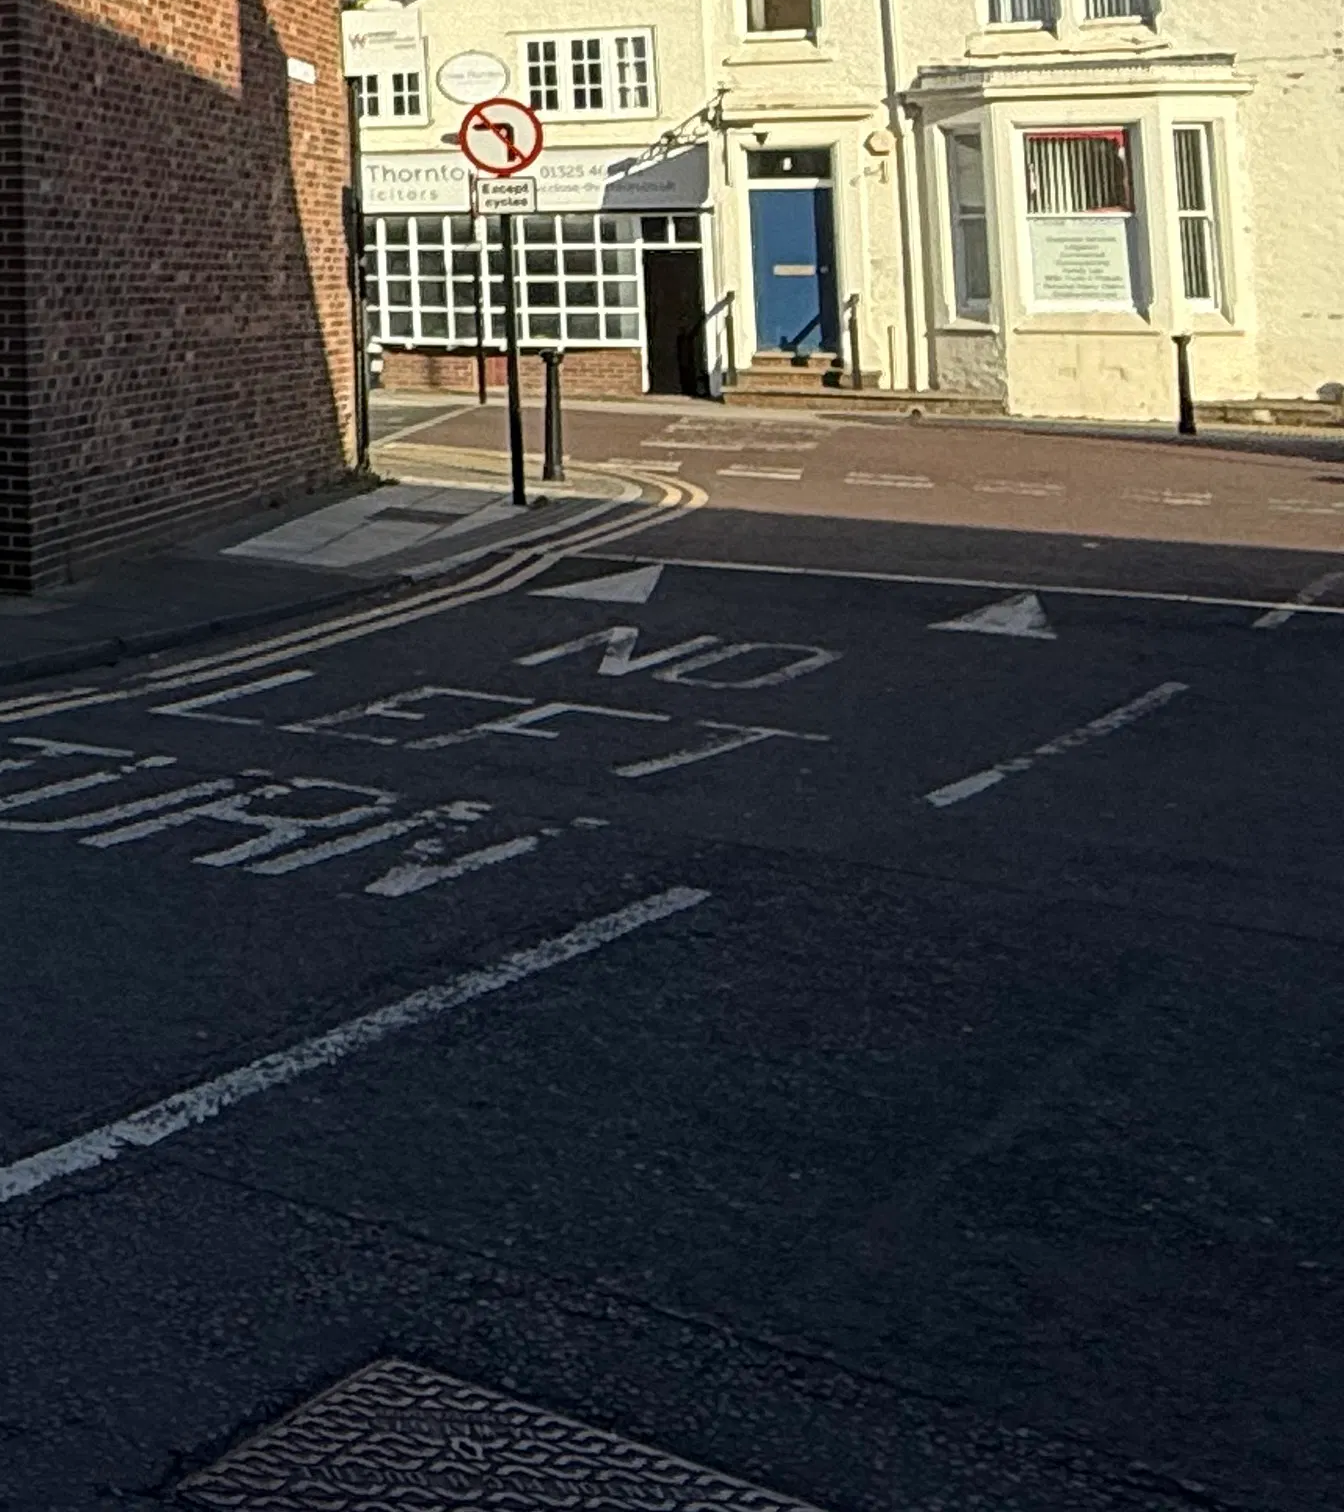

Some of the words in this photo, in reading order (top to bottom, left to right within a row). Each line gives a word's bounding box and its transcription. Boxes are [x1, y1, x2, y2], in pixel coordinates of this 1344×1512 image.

[366, 165, 465, 183] Thornto
[482, 182, 529, 195] Except
[485, 197, 528, 209] cycles
[513, 626, 842, 688] NO
[148, 669, 830, 778] LEFT
